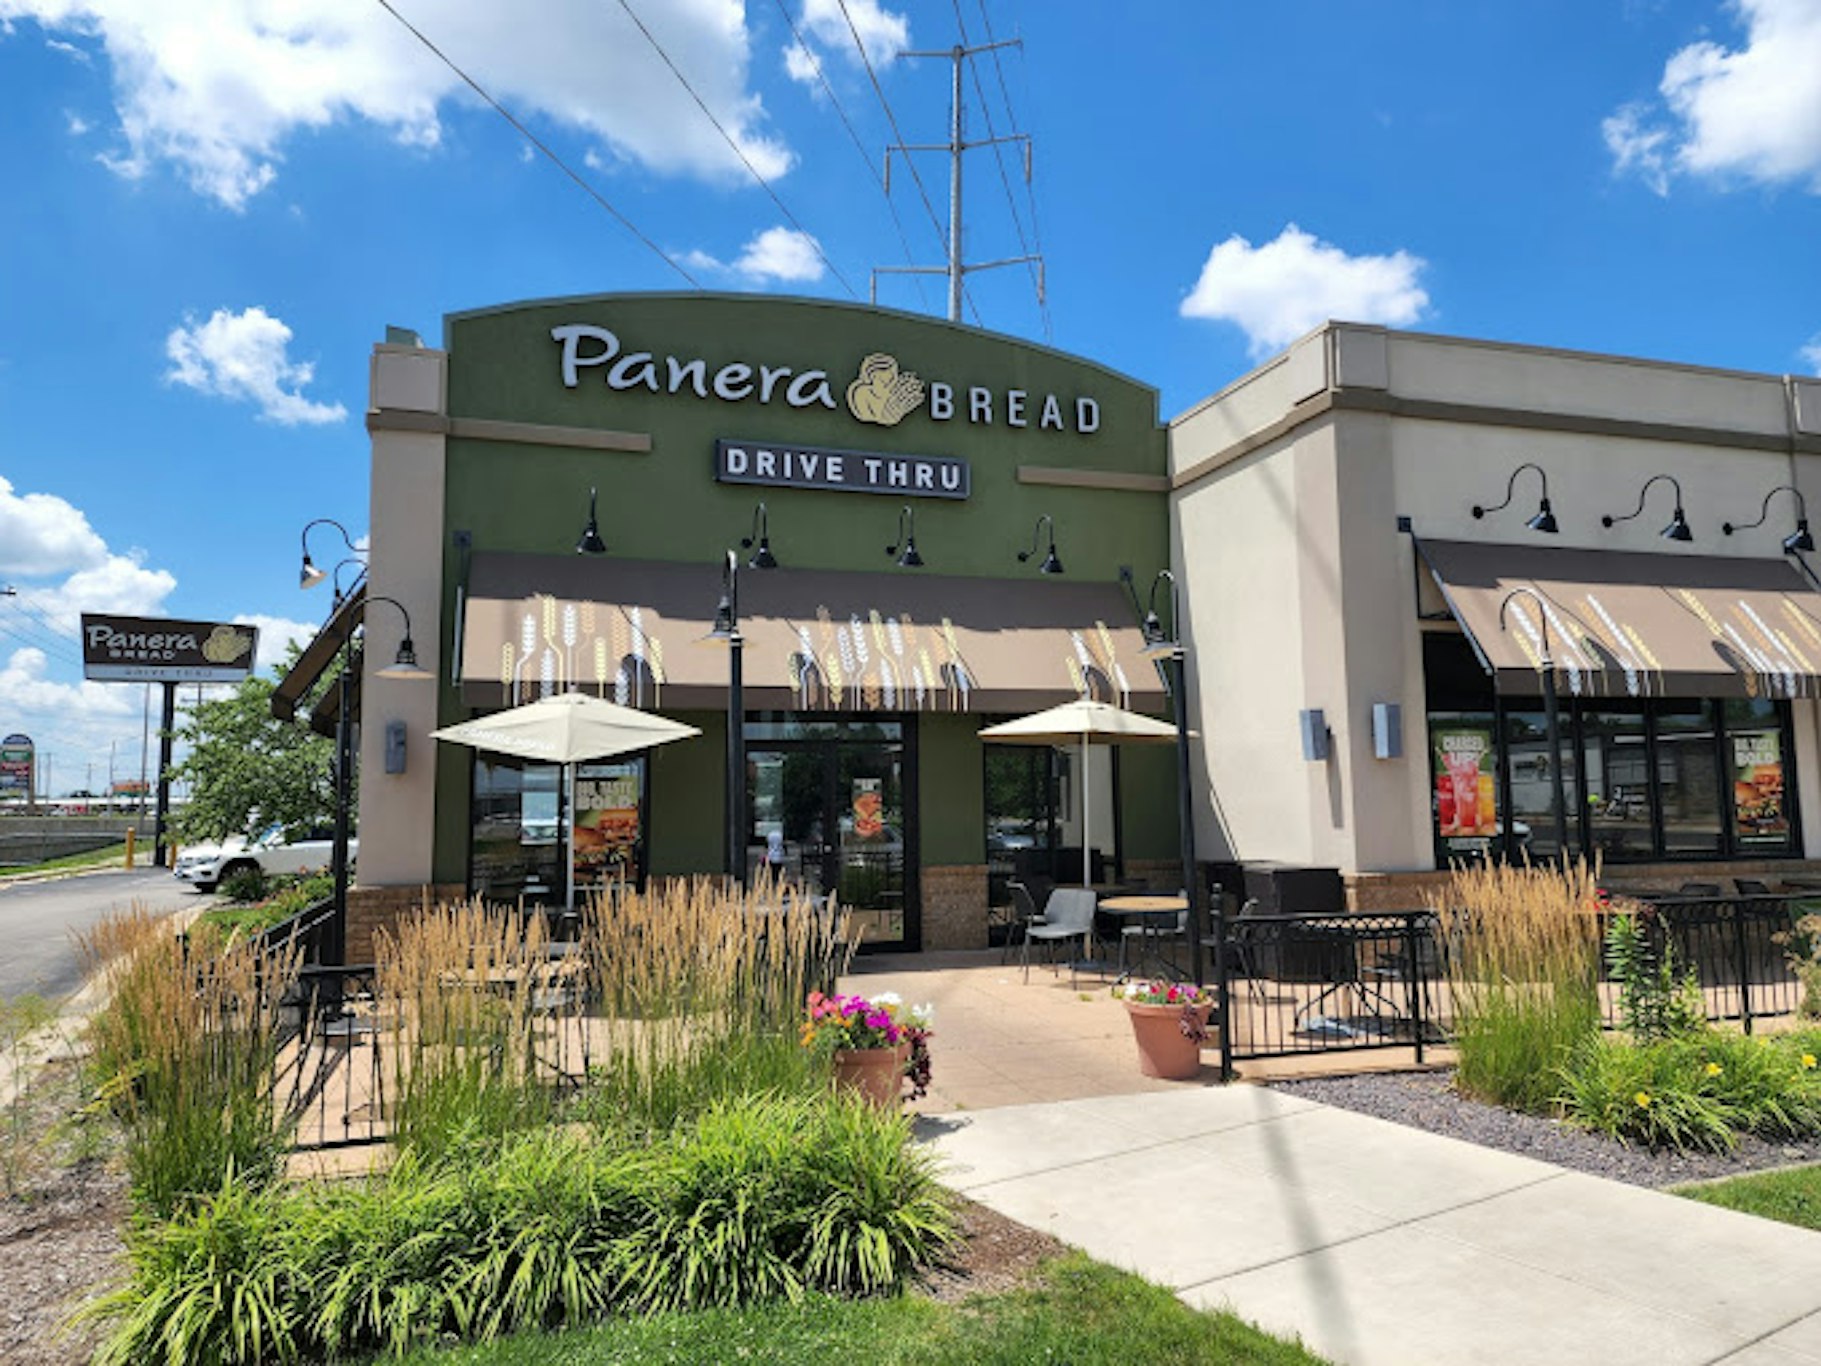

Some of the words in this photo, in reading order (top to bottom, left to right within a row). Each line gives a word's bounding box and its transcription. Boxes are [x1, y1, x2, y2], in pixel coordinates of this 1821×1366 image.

[551, 324, 837, 409] Panera
[930, 382, 1100, 433] BREAD
[726, 448, 844, 482] DRIVE
[864, 460, 961, 490] THRU
[86, 624, 197, 650] Panera
